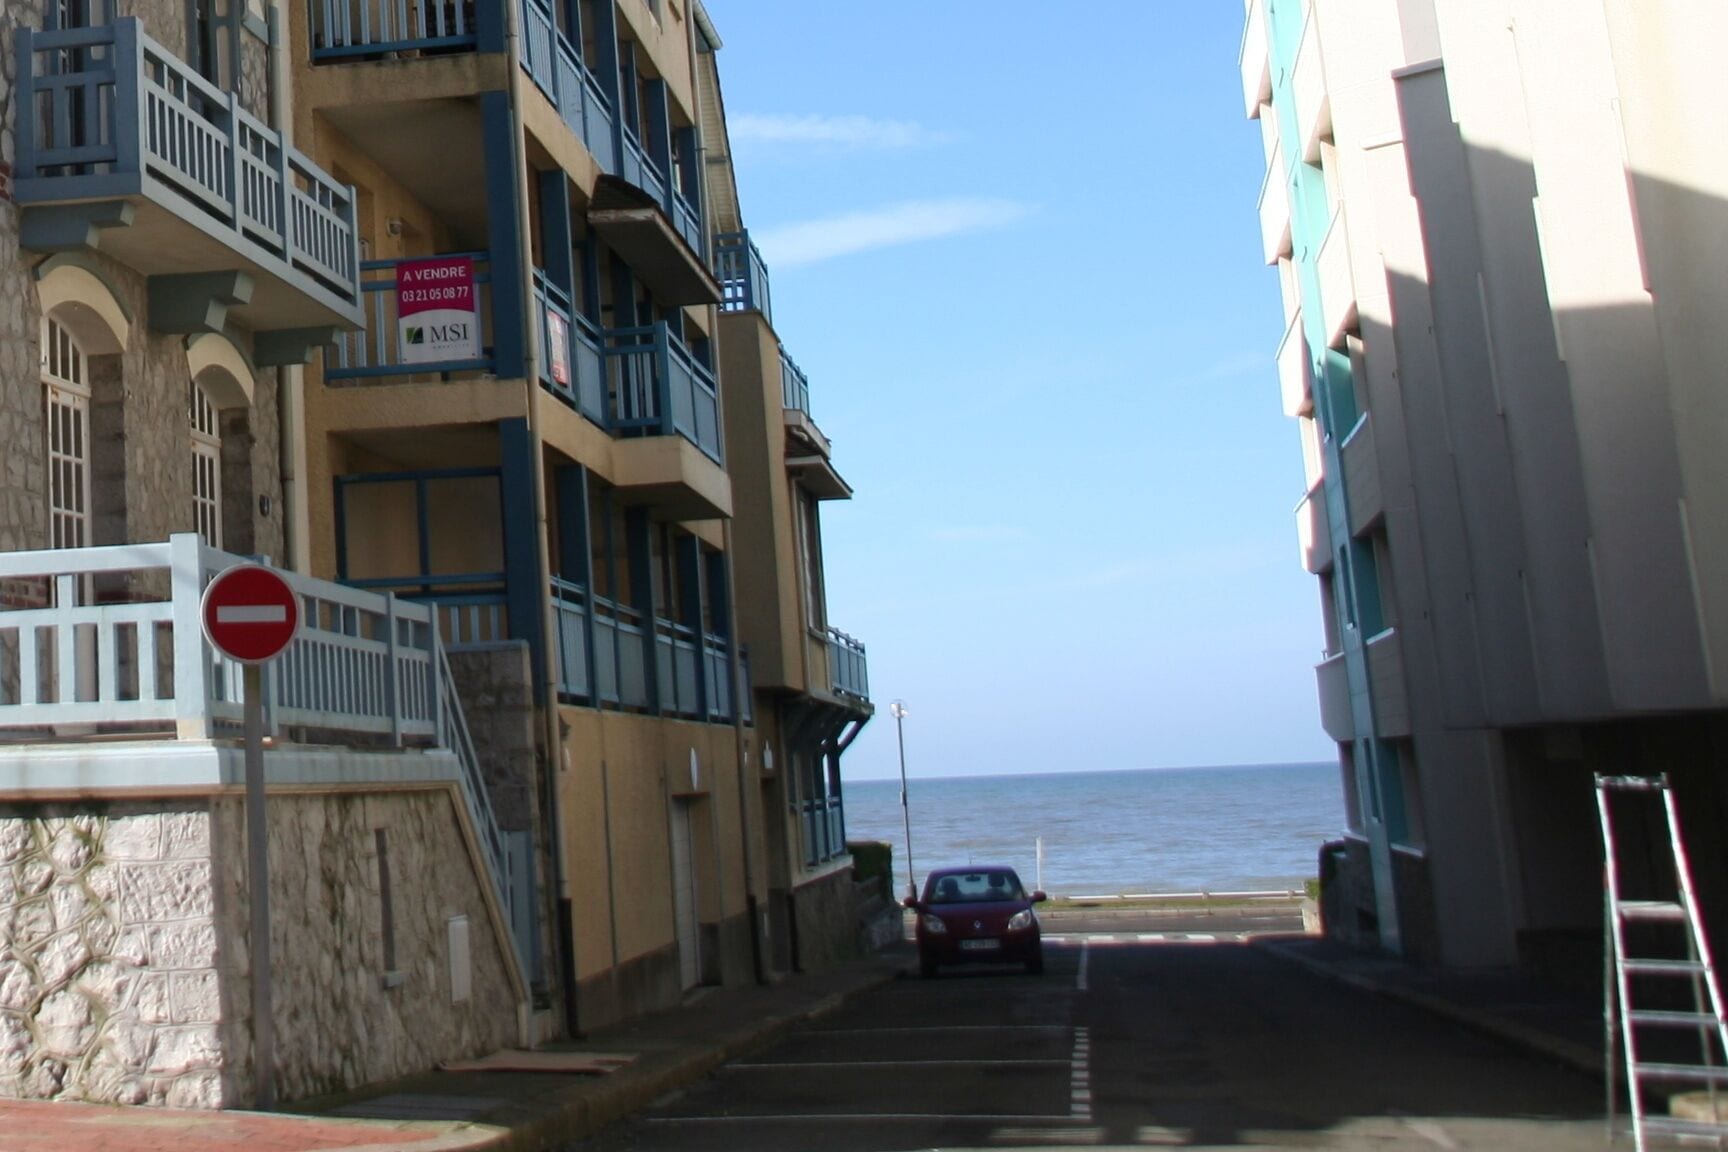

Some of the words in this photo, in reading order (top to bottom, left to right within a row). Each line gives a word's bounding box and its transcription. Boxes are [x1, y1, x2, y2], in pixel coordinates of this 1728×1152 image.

[403, 270, 412, 282] A
[414, 266, 466, 281] VENDRE
[402, 290, 414, 302] 03
[416, 289, 428, 301] 21
[429, 288, 441, 300] 05
[443, 287, 455, 299] 08
[456, 286, 469, 298] 77
[430, 323, 469, 343] MSI
